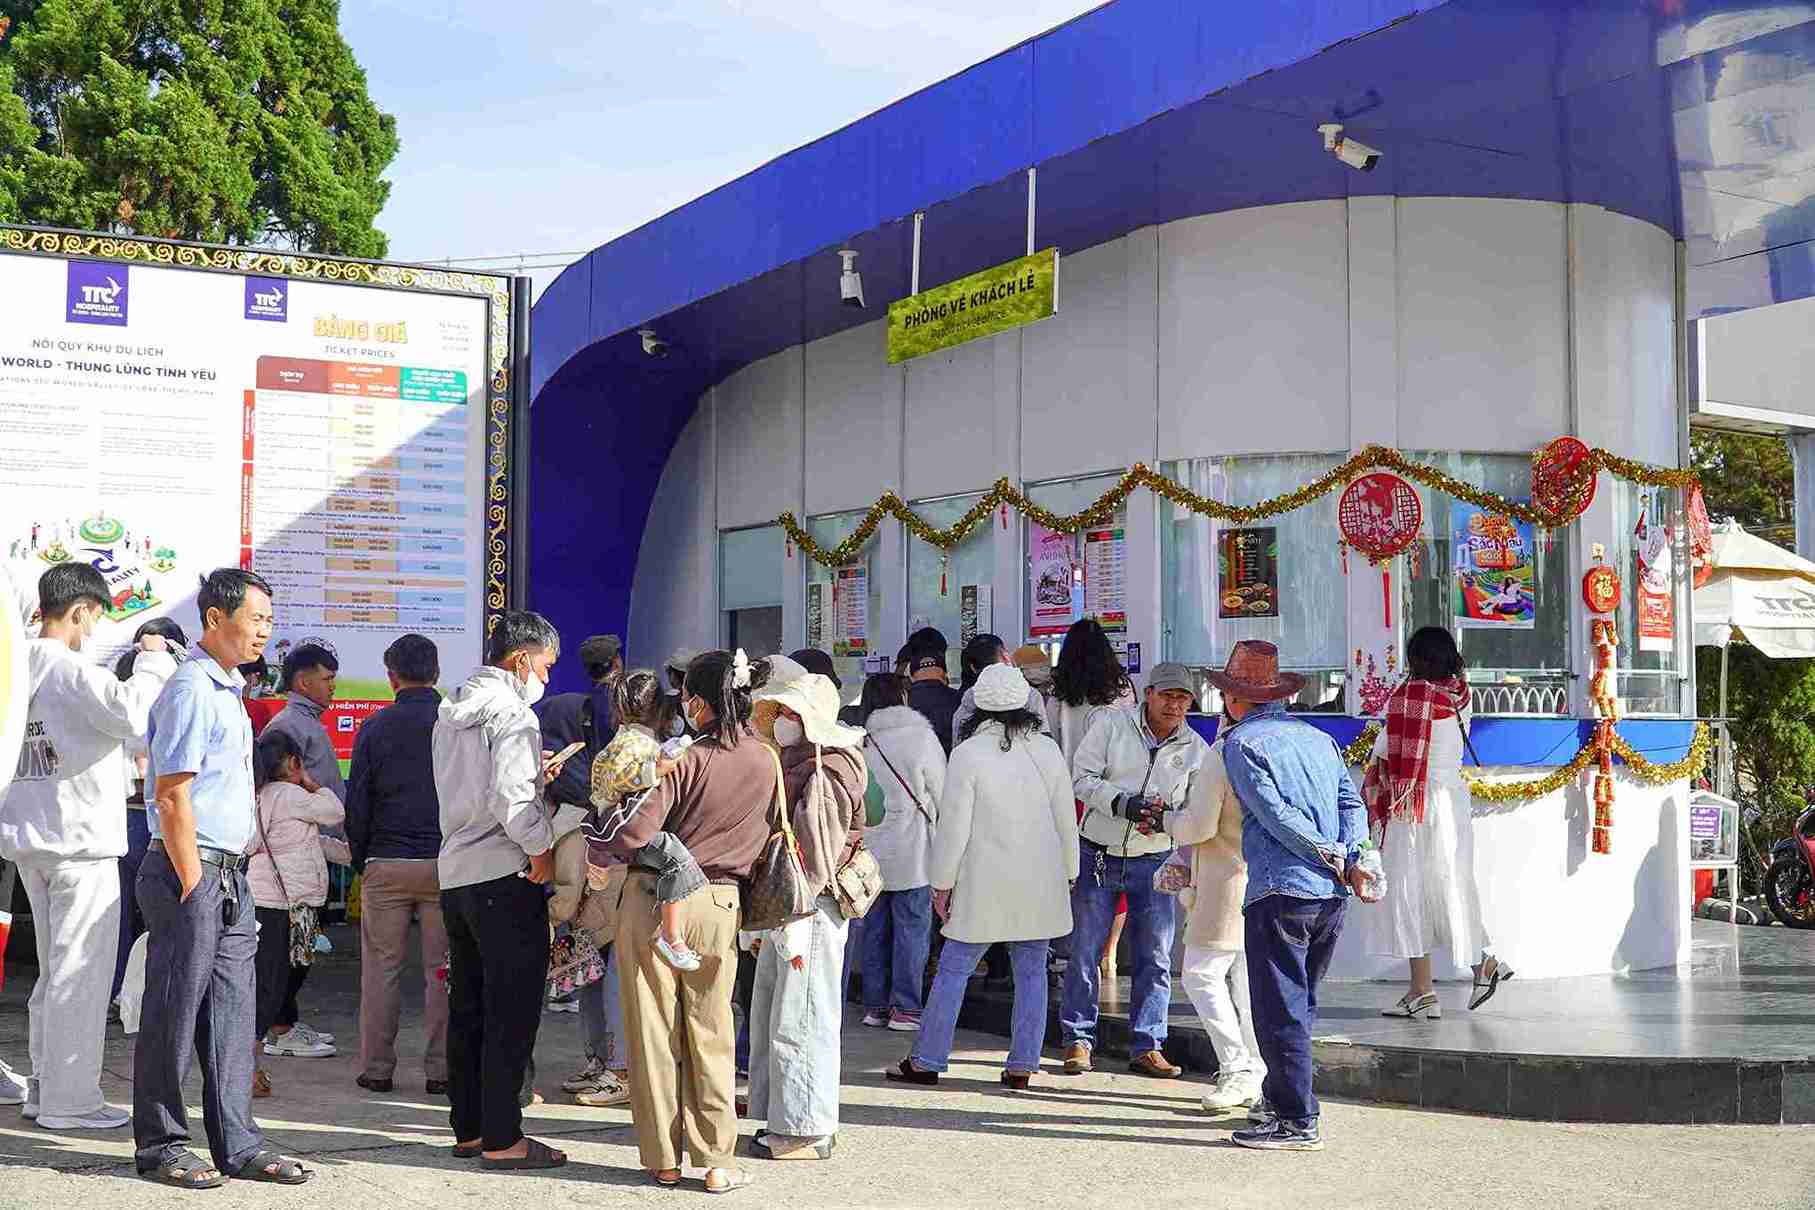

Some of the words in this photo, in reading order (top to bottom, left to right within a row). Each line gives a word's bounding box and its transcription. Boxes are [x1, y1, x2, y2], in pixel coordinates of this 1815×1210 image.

[905, 304, 948, 328] PHÒNG
[970, 281, 1017, 308] KHÁCH
[57, 340, 82, 352] QUY
[87, 343, 112, 354] KHU
[1, 356, 53, 369] WORLD
[66, 360, 112, 374] THUNG
